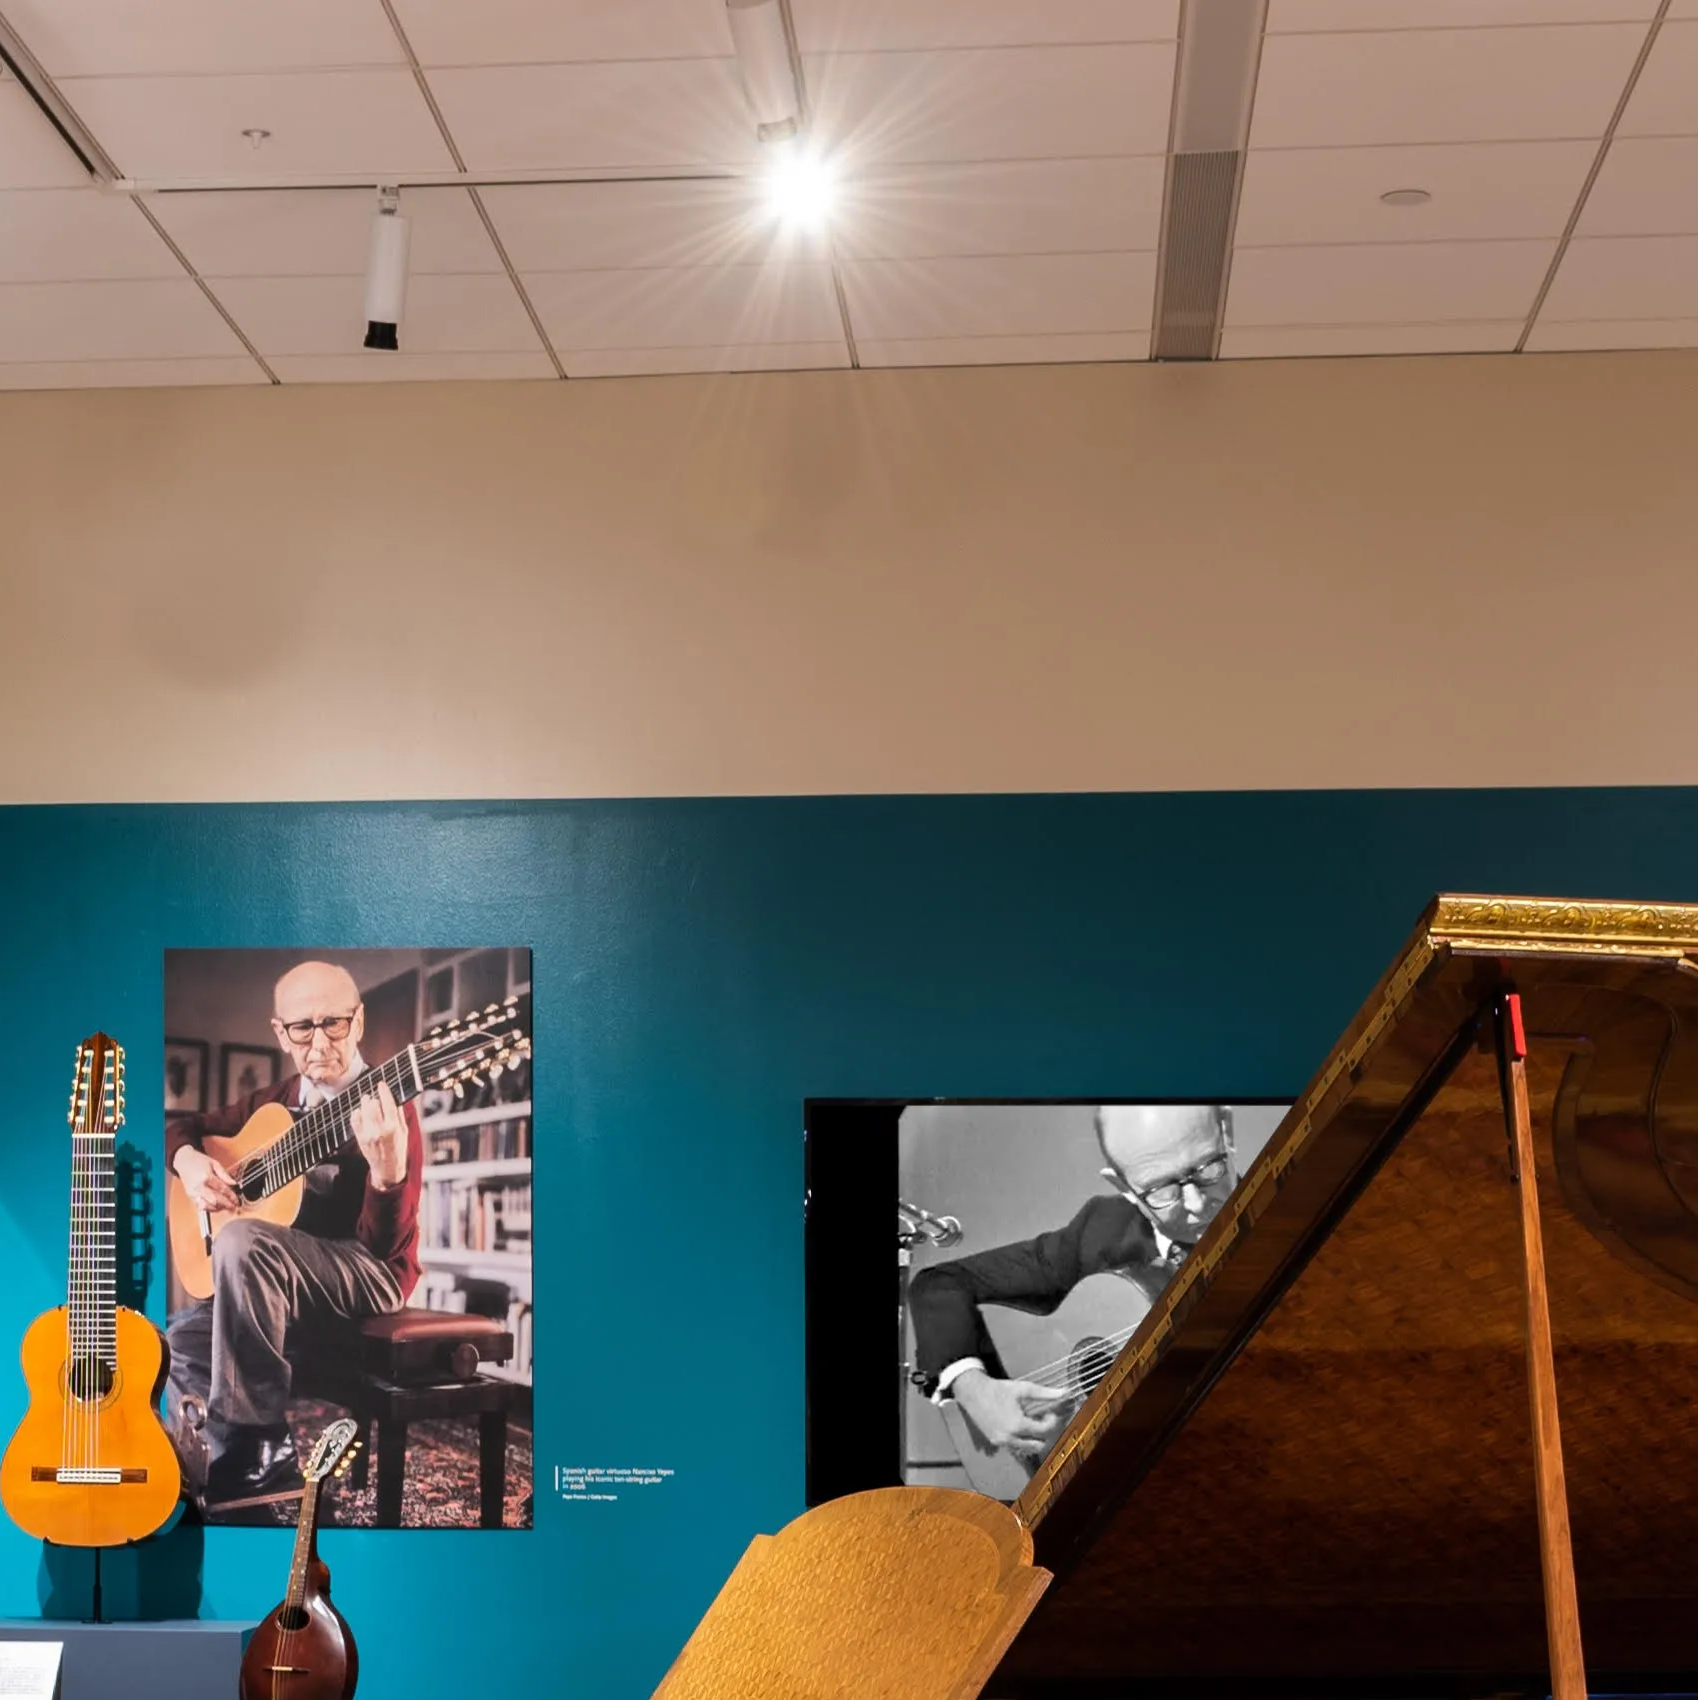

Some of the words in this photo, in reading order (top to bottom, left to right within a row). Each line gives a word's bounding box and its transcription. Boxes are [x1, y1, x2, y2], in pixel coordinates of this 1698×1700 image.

[562, 1467, 586, 1476] Spanish
[587, 1468, 605, 1476] guitar
[644, 1477, 662, 1485] guitar
